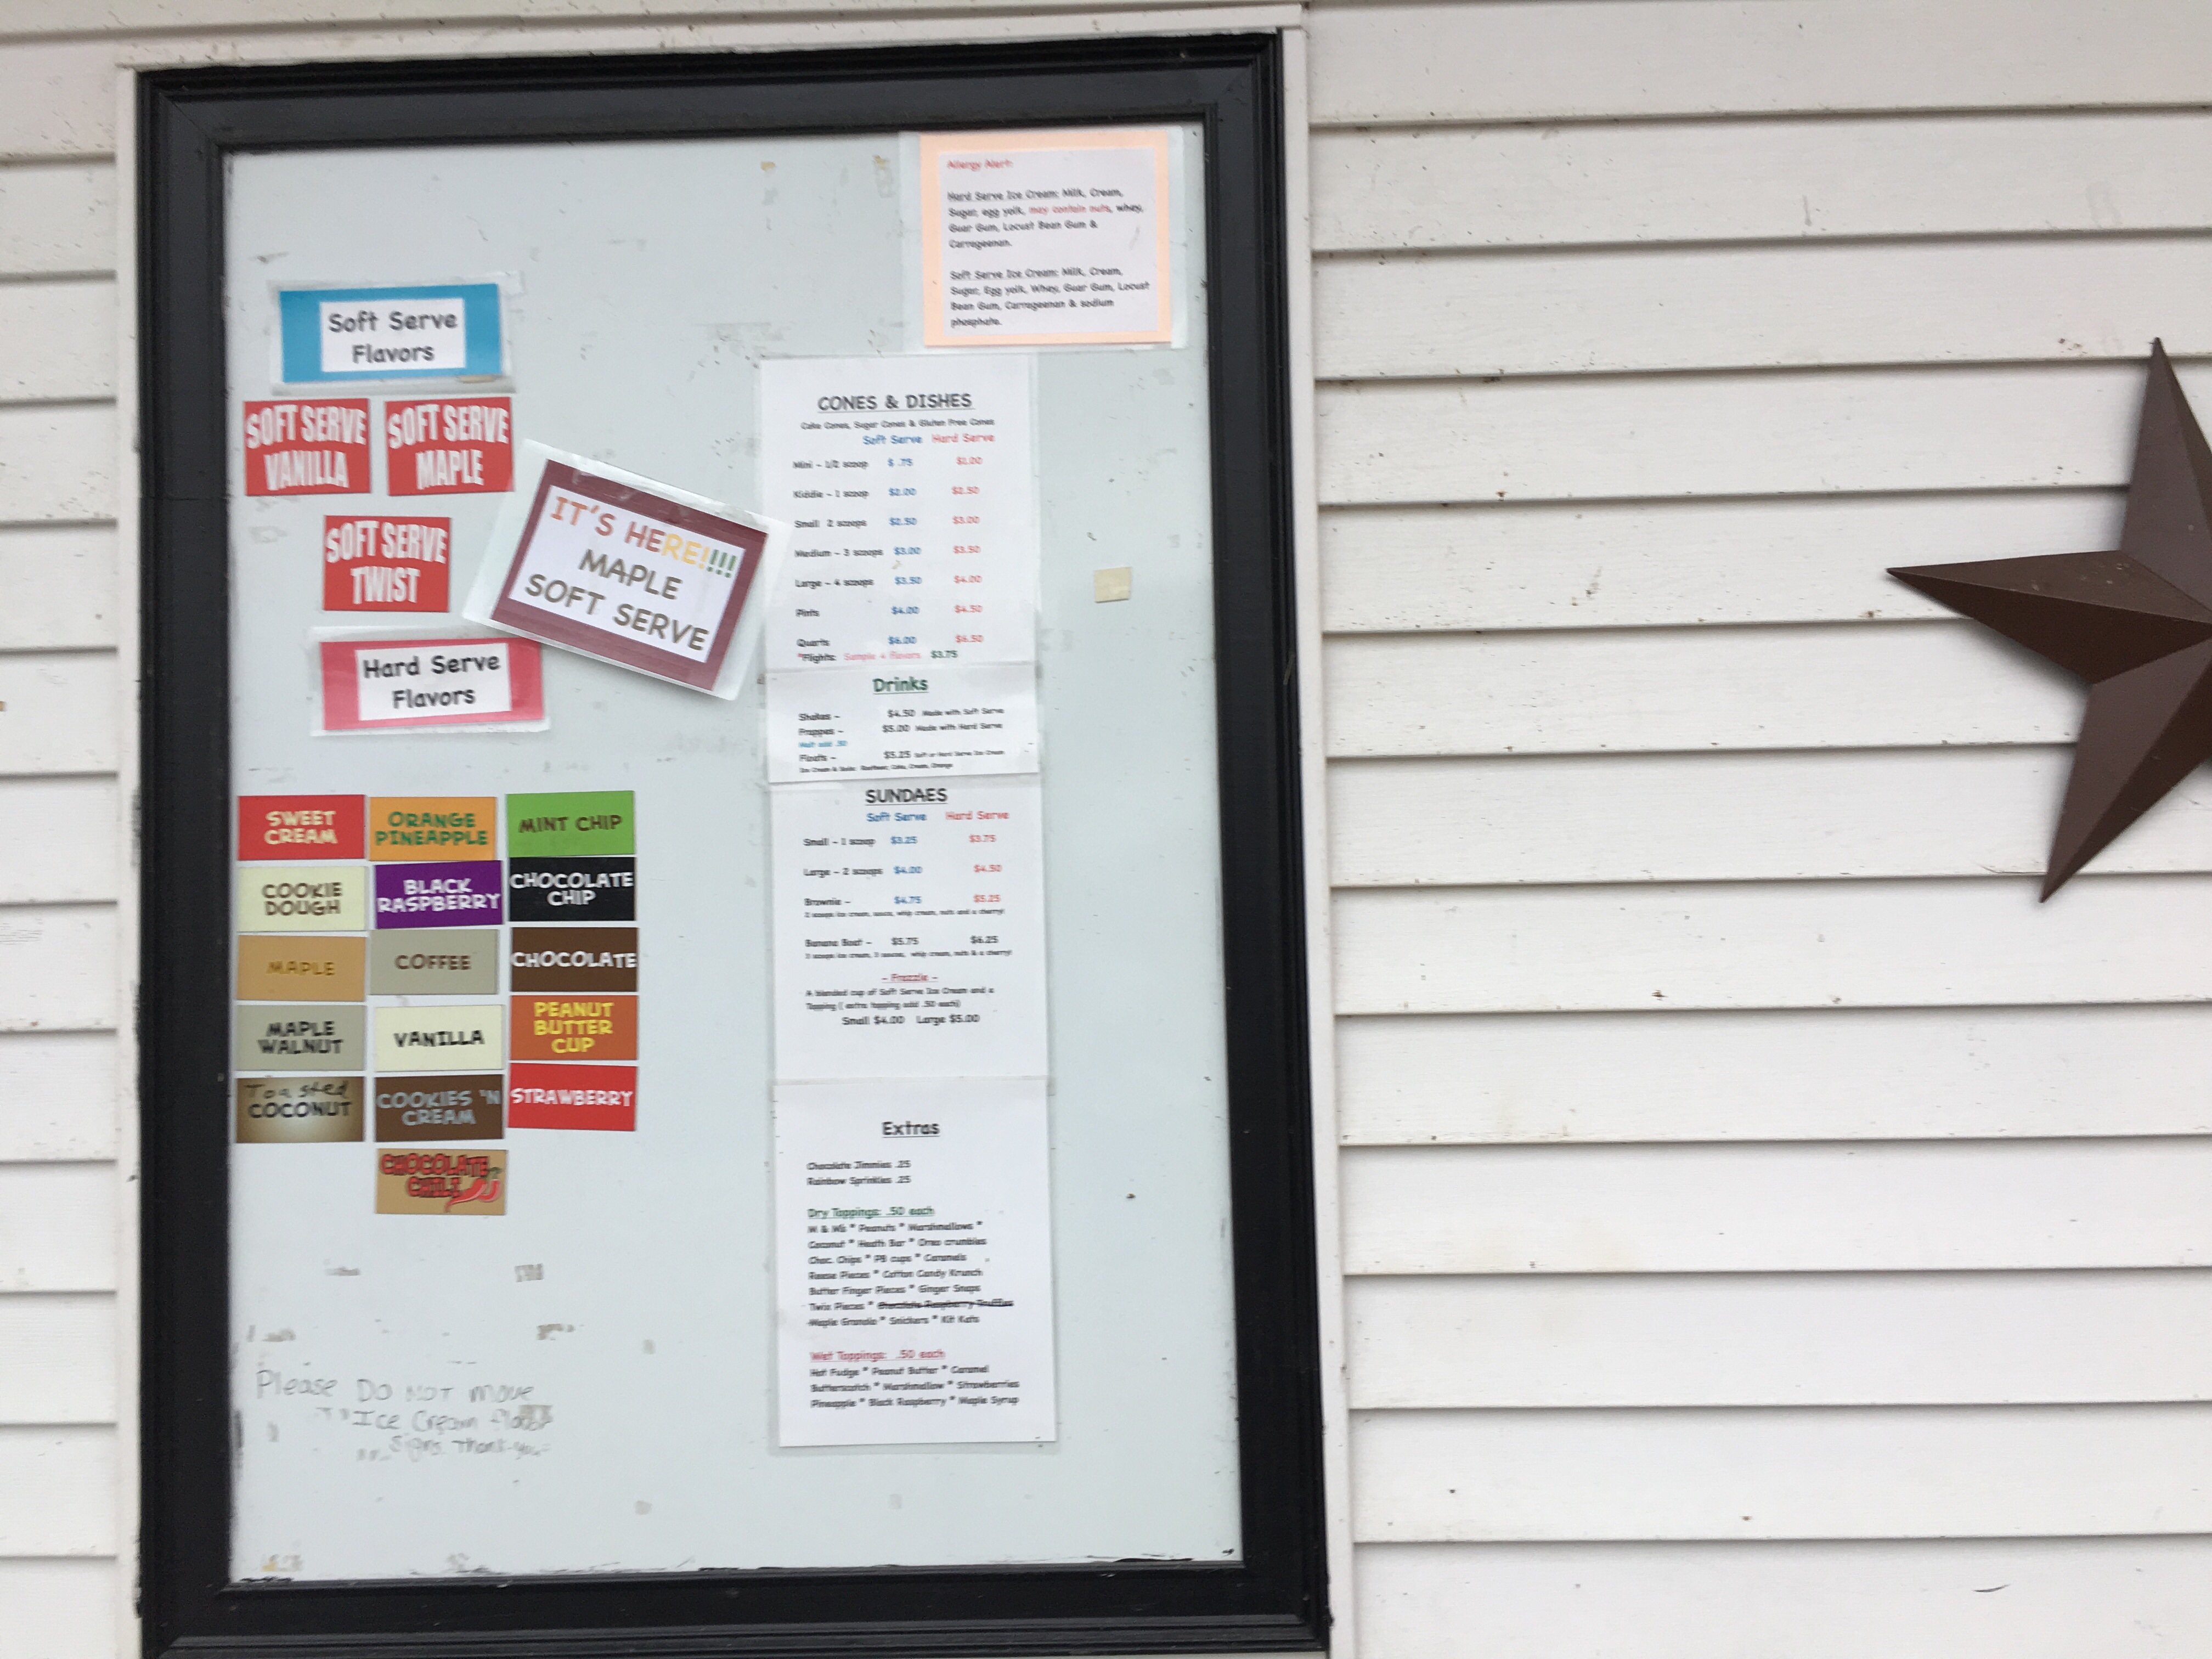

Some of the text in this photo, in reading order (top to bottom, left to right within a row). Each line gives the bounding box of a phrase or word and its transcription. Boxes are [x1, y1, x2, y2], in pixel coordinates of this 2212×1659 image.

[948, 191, 972, 200] Hard
[975, 190, 1003, 200] Serve
[1006, 190, 1022, 199] Ice
[1062, 188, 1086, 199] Milk,
[1090, 187, 1123, 198] Cream,
[981, 207, 1000, 218] egg
[1003, 206, 1025, 217] yolk,
[1029, 206, 1048, 216] may
[1053, 205, 1086, 215] contain
[1116, 203, 1143, 214] whey,
[949, 224, 973, 232] Guar
[977, 223, 1000, 233] Gum,
[1003, 221, 1034, 232] Locust
[1039, 220, 1062, 229] Bean
[1065, 220, 1086, 229] Gum
[949, 239, 1012, 250] Carrageenan.
[950, 270, 971, 280] Soft
[975, 270, 1003, 279] Serve
[1007, 269, 1022, 278] Ice
[1062, 267, 1085, 277] Milk,
[1090, 267, 1122, 276] Cream,
[984, 286, 1002, 297] Egg
[1005, 285, 1027, 296] yolk,
[1031, 284, 1060, 295] Whey,
[1063, 283, 1087, 292] Guar
[1091, 282, 1114, 292] Gum,
[1118, 281, 1149, 290] Locust
[951, 298, 1114, 311] Bean Gum, Carrageenan & sodium
[330, 311, 458, 334] Soft Serve
[951, 317, 1002, 328] phosphate.
[352, 344, 435, 364] Flavors
[817, 393, 972, 411] CONES & DISHES
[246, 404, 367, 449] SOFT SERVE
[388, 404, 509, 449] SOFT SERVE
[863, 434, 995, 445] Soft Serve Hard Serve
[263, 450, 349, 491] VANILLA
[415, 449, 484, 490] MAPLE
[793, 456, 983, 469] Mini $1.00
[793, 486, 980, 499] Kiddie $2.00 $2.50
[550, 496, 617, 537] IT'S
[794, 516, 980, 528] Small $2.50 $3.00
[326, 520, 447, 565] SOFT SERVE
[794, 545, 981, 557] Medium $3.00 $3.50
[578, 549, 683, 600] MAPLE
[795, 575, 983, 589] Large $3.50 $4.00
[350, 566, 420, 605] TWIST
[525, 574, 710, 651] SOFT SERVE
[795, 605, 983, 617] Pints $4.00 $4.50
[797, 639, 830, 647] Quarts
[888, 636, 917, 645] $6.00
[364, 654, 501, 679] Hard Serve
[873, 677, 928, 692] Drinks
[392, 689, 476, 709] Flavors
[888, 709, 916, 718] $4.50
[798, 724, 910, 737] Frappes $5.00
[799, 754, 827, 762] Floats
[865, 788, 947, 803] SUNDAES
[266, 810, 337, 827] SWEET
[388, 811, 476, 828] ORANGE
[518, 814, 623, 834] MINT CHIP
[867, 811, 1009, 822] Soft Serve Hard Serve
[264, 828, 337, 845] CREAM
[375, 829, 489, 847] PINEAPPLE
[803, 834, 996, 846] Small $3.25 $3.75
[510, 872, 634, 889] CHOCOLATE
[803, 868, 831, 878] Large
[894, 866, 922, 874] $4.00
[262, 882, 342, 900] COOKIE
[403, 877, 472, 896] BLACK
[377, 893, 501, 913] RASPBERRY
[548, 890, 596, 906] CHIP
[804, 898, 842, 906] Brownie
[894, 896, 922, 904] $4.75
[265, 900, 341, 916] DOUGH
[891, 937, 919, 945] $5.75
[970, 936, 999, 944] $6.25
[266, 960, 335, 977] MAPLE
[394, 954, 472, 970] COFFEE
[511, 951, 637, 969] CHOCOLATE
[534, 1001, 614, 1019] PEANUT
[266, 1020, 335, 1037] MAPLE
[534, 1019, 613, 1036] BUTTER
[258, 1039, 343, 1054] WALNUT
[394, 1030, 484, 1047] VANILLA
[551, 1037, 595, 1053] CUP
[377, 1091, 473, 1109] COOKIES
[511, 1088, 634, 1108] STRAWBERRY
[248, 1101, 352, 1119] COCONUT
[402, 1109, 476, 1126] CREAM
[882, 1121, 940, 1136] Extras
[381, 1153, 490, 1176] CHOCOLATE
[807, 1161, 892, 1170] Chocolate Jimmies
[408, 1176, 462, 1199] CHILI
[807, 1177, 892, 1186] Rainbow Sprinkles
[808, 1209, 829, 1218] Dry
[909, 1206, 935, 1215] each
[810, 1365, 989, 1378] Hot Fudge Peanut Butter Caramel
[256, 1369, 337, 1398] Please
[405, 1385, 454, 1402] NOT
[352, 1410, 402, 1429] Ice
